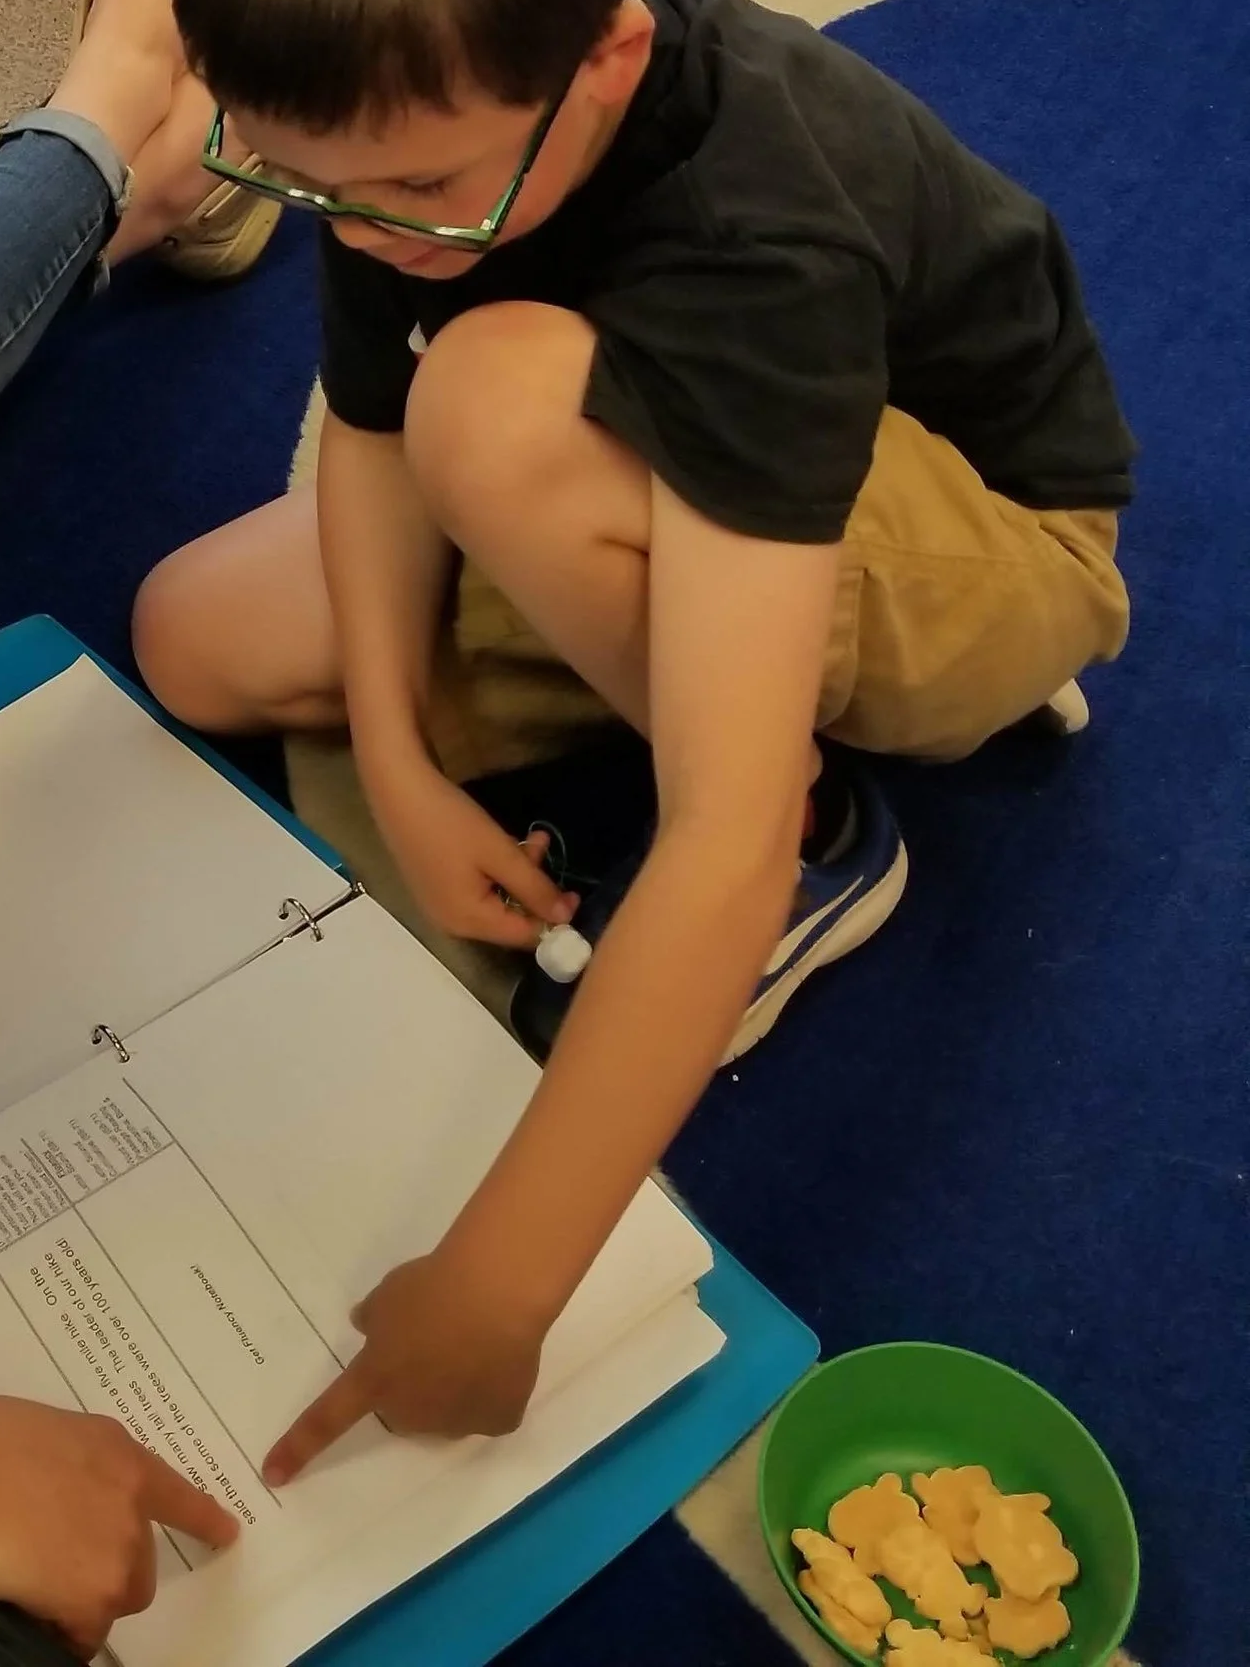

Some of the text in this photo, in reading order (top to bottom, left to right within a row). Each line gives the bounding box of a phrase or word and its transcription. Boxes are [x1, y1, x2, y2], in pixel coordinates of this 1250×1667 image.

[30, 1267, 45, 1287] the
[44, 1252, 63, 1278] hike
[43, 1286, 57, 1306] On
[60, 1278, 76, 1296] our
[71, 1298, 85, 1310] of
[190, 1264, 264, 1365] Get Fluency Notebook!
[83, 1313, 111, 1350] leader
[77, 1339, 97, 1364] mile
[108, 1349, 125, 1373] The
[55, 1237, 256, 1525] said that some of the trees were over 100 years old!
[95, 1366, 112, 1388] five
[109, 1388, 118, 1397] a
[116, 1398, 129, 1414] on
[126, 1414, 149, 1444] went
[147, 1412, 165, 1431] tall
[163, 1432, 188, 1464] many
[186, 1467, 207, 1492] saw
